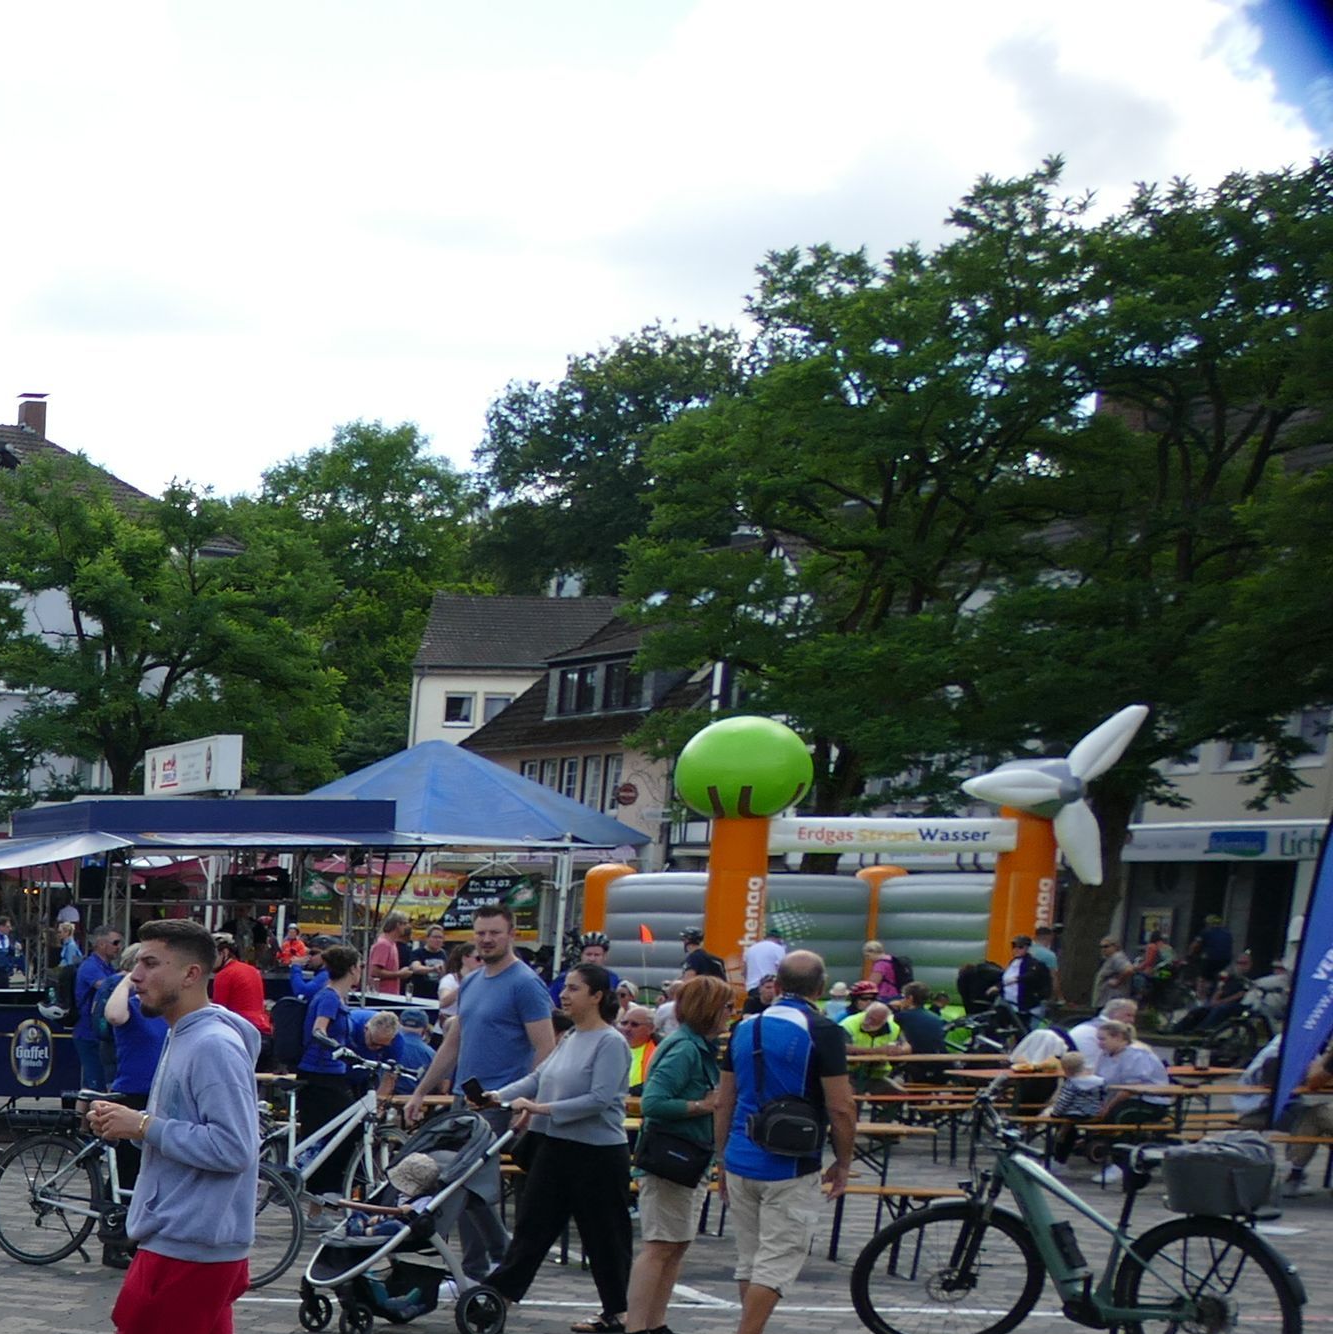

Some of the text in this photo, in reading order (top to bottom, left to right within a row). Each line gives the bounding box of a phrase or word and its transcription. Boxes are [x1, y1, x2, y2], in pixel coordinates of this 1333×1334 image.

[797, 827, 853, 845] Erdgas
[919, 827, 990, 842] Wasser
[15, 1045, 49, 1060] Gaffel
